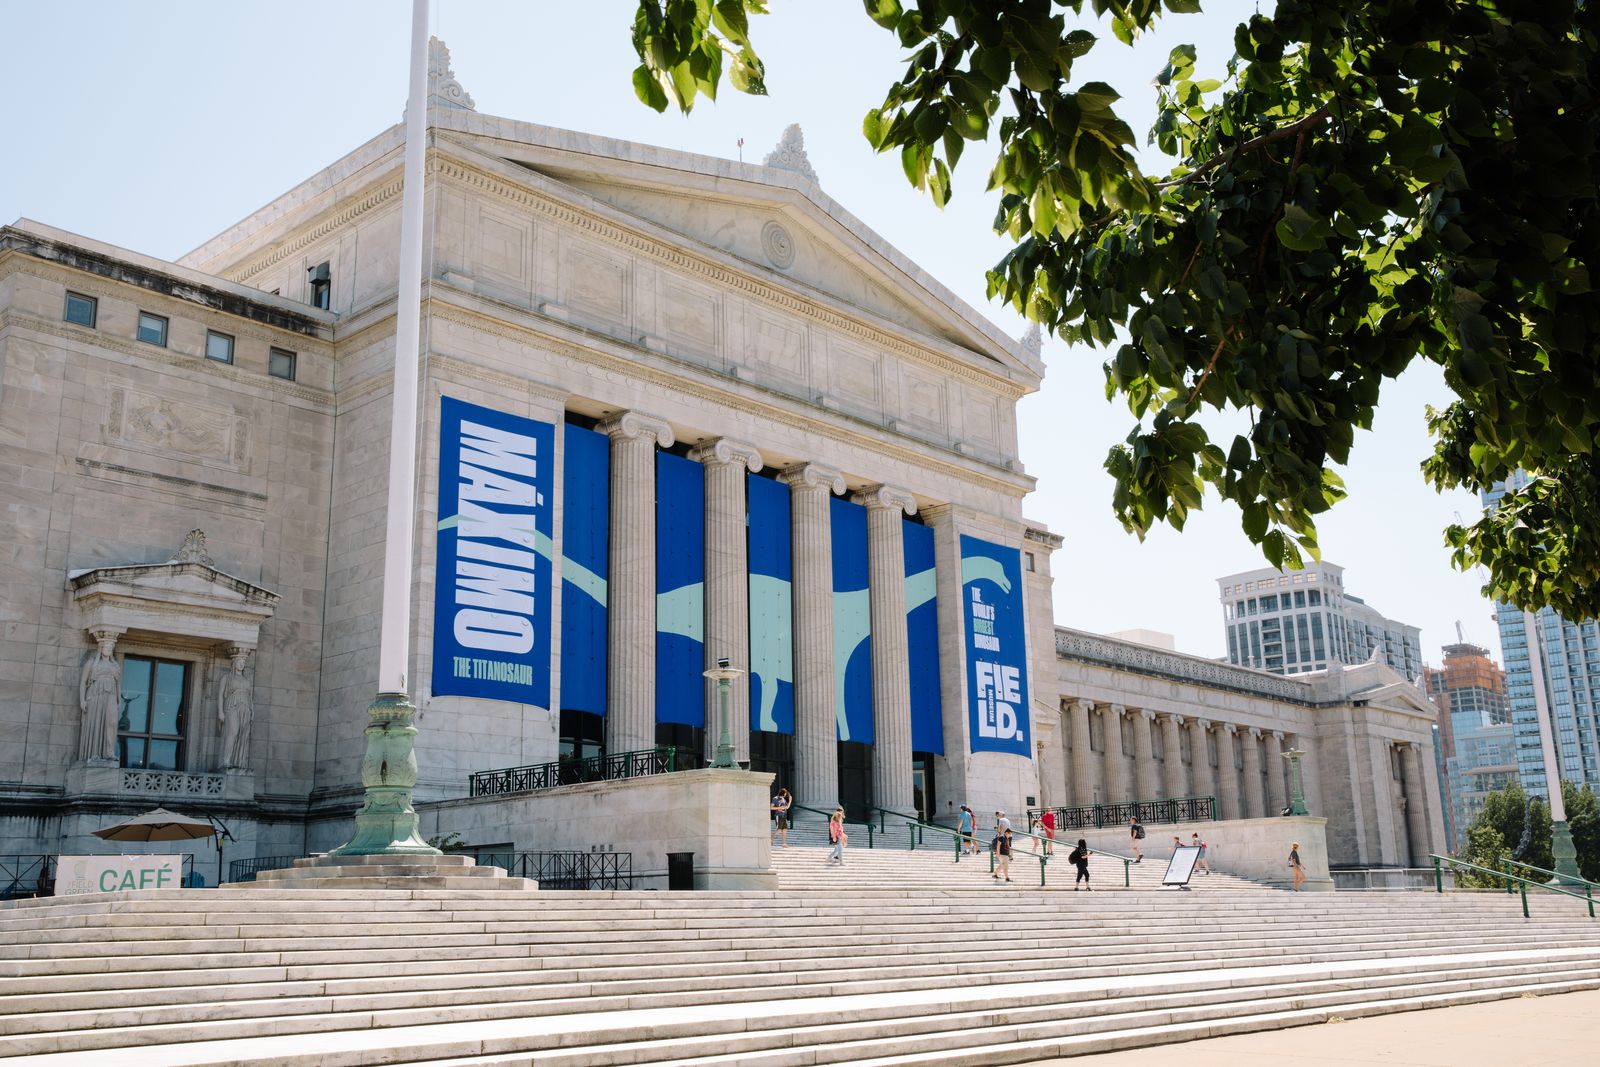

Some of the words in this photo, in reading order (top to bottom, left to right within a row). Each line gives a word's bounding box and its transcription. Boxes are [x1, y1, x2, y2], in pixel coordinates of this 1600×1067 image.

[453, 419, 544, 654] MÁXIMO
[453, 656, 471, 678] THE
[472, 658, 533, 686] TITANOSAUR
[99, 863, 172, 893] CAFÉ
